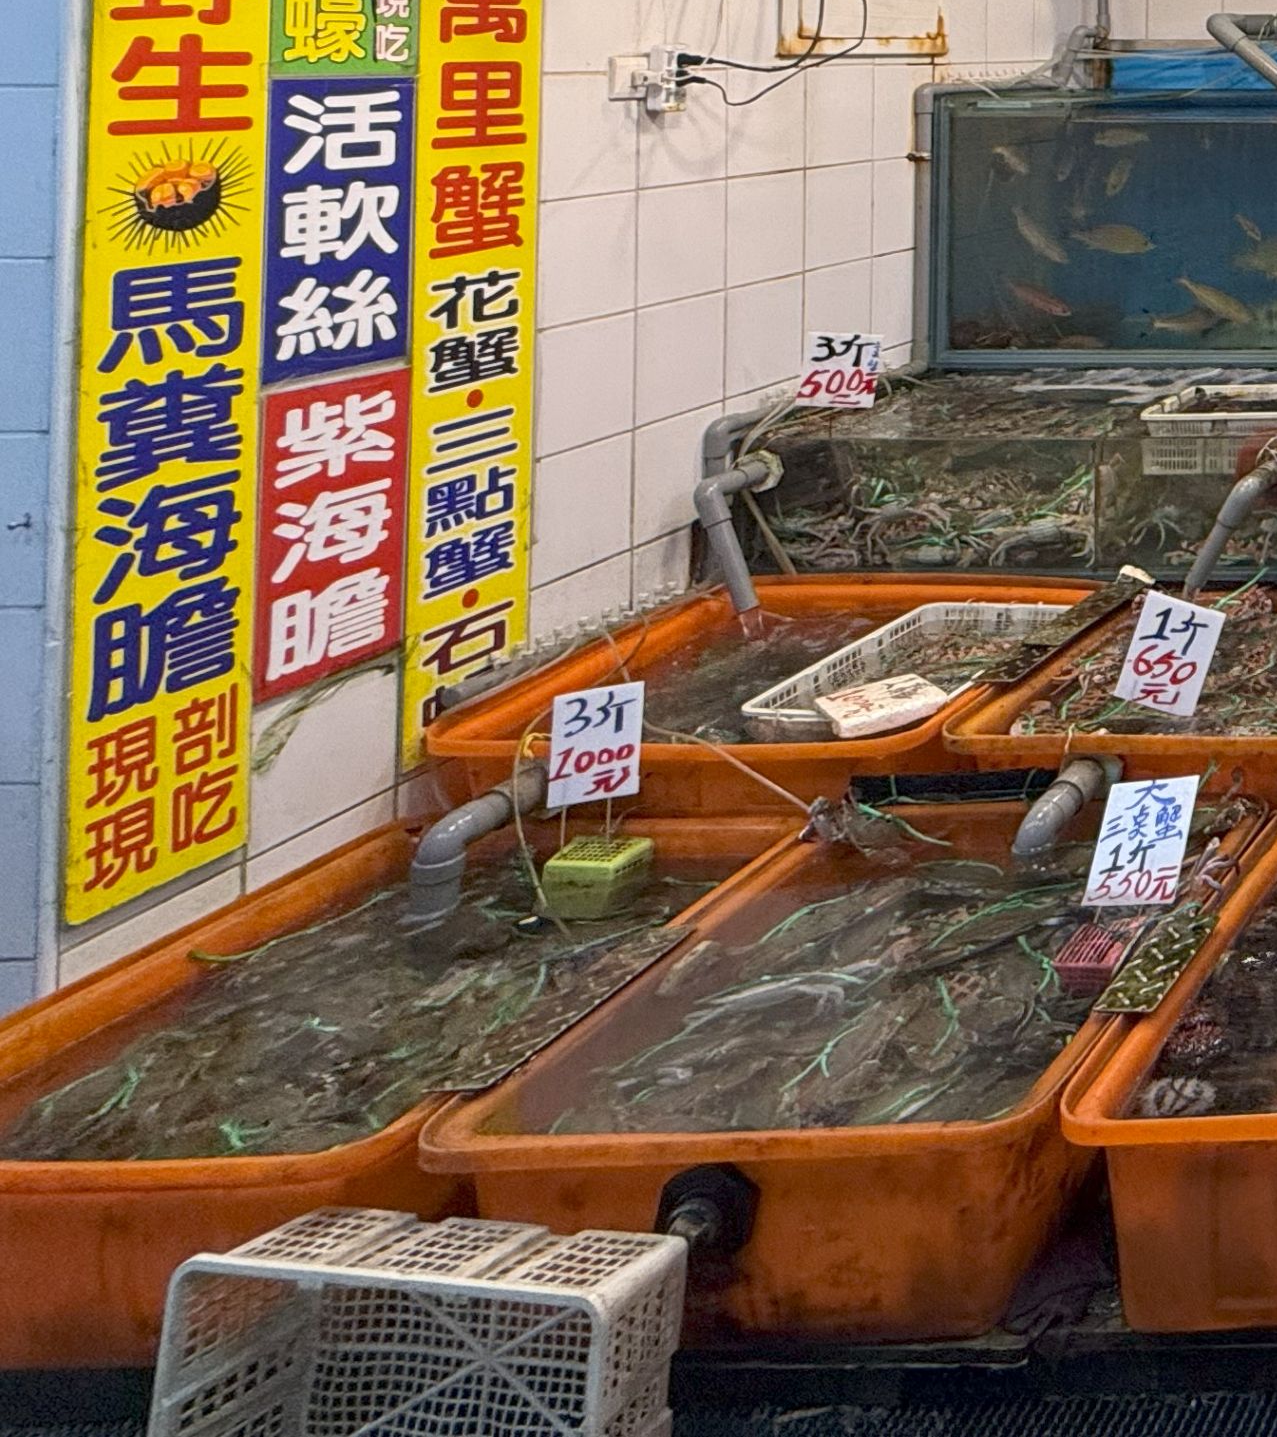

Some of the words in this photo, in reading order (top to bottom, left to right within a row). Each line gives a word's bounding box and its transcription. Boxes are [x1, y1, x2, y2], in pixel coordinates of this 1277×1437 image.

[276, 90, 402, 362] 活軟絲
[811, 335, 876, 367] 3斤
[796, 369, 877, 399] 500元
[87, 257, 245, 722] 馬糞海膽
[265, 390, 396, 682] 紫海膽
[1139, 608, 1209, 656] 1斤
[1133, 645, 1197, 685] 650
[1133, 682, 1180, 705] 元
[564, 691, 637, 738] 3斤
[549, 743, 635, 782] 1000
[583, 766, 631, 796] 元
[1125, 779, 1176, 810] 大
[1100, 839, 1156, 875] 1斤
